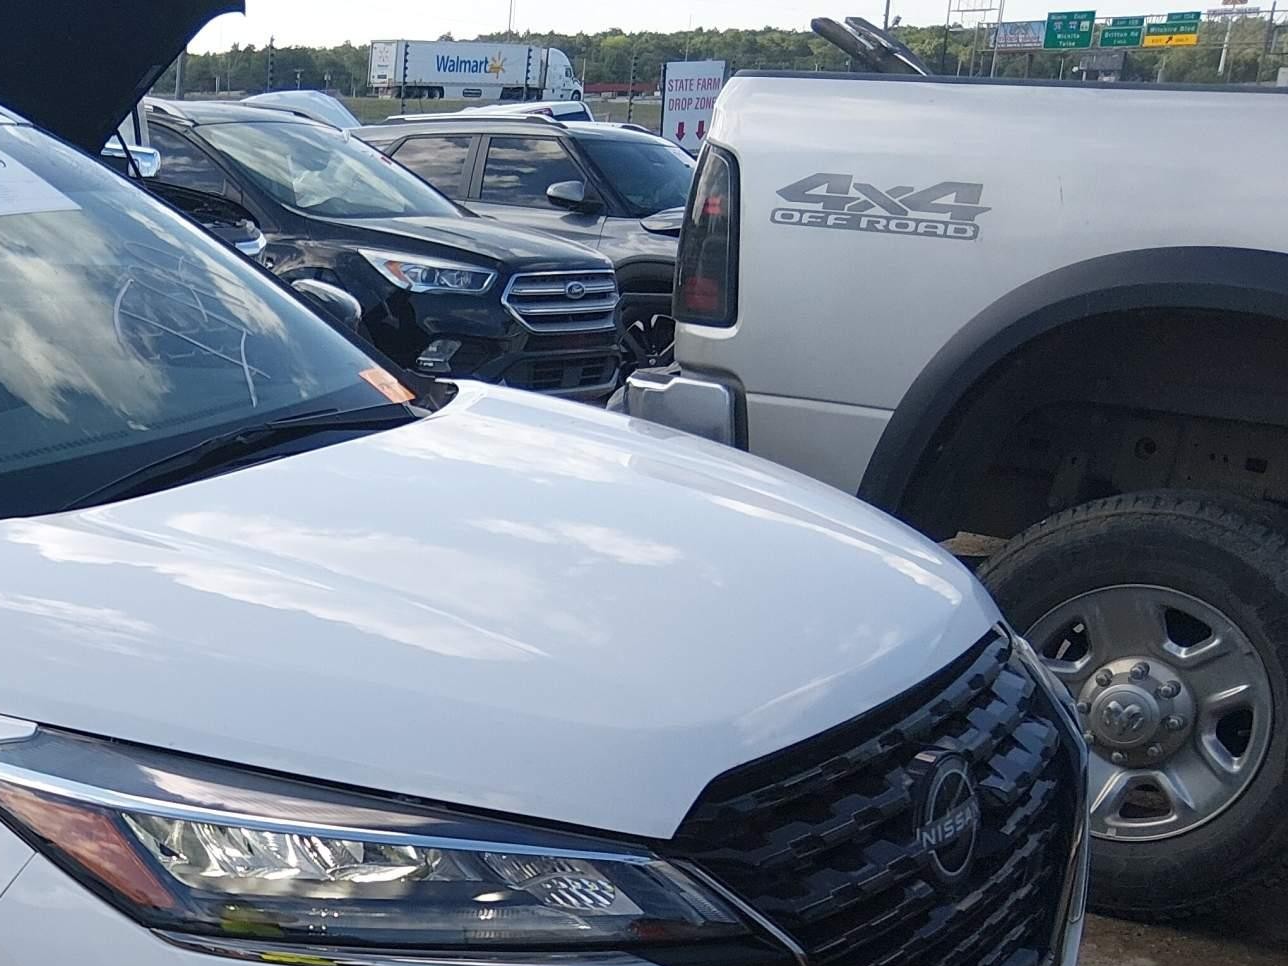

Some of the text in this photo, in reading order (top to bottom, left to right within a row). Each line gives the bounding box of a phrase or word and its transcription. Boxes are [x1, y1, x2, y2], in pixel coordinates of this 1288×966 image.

[436, 55, 489, 73] Walmart
[667, 77, 721, 92] STATE FARM
[668, 98, 693, 112] DROP
[773, 209, 976, 238] OFF ROAD
